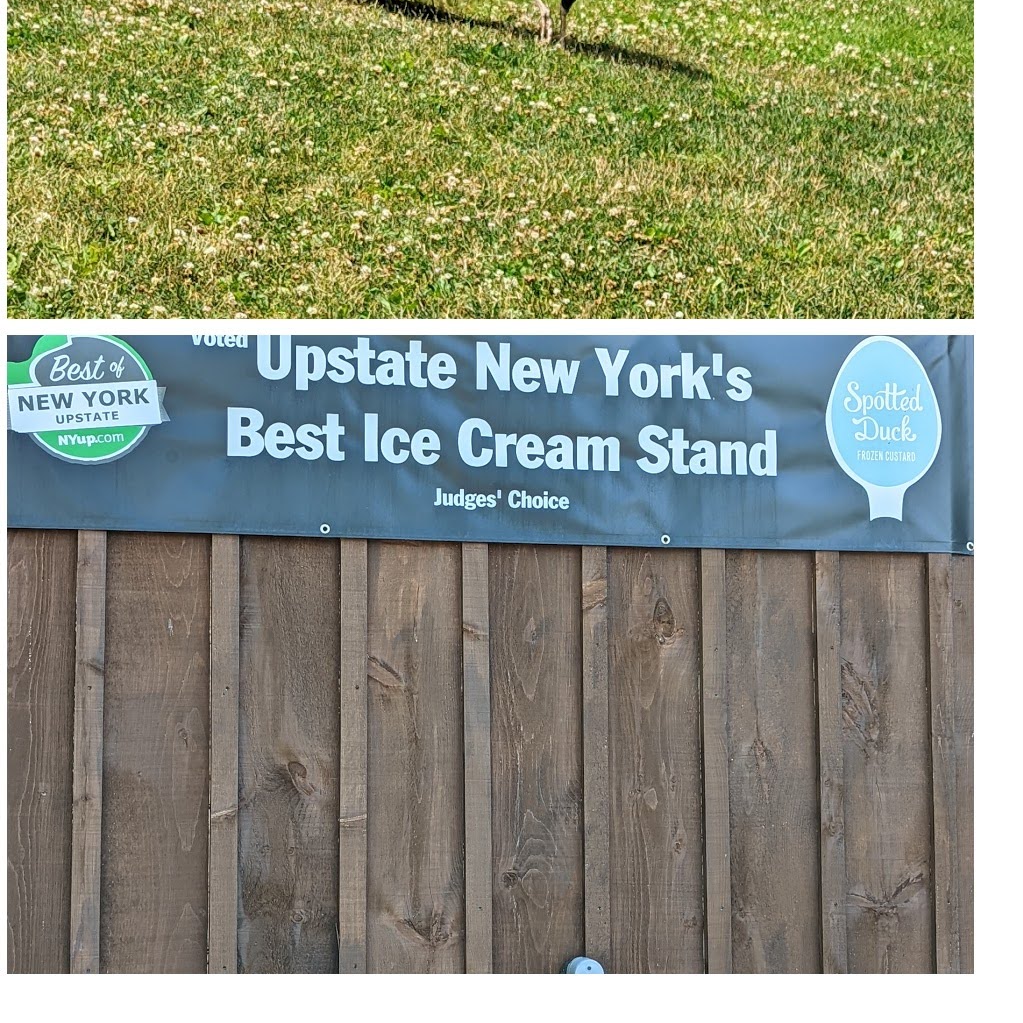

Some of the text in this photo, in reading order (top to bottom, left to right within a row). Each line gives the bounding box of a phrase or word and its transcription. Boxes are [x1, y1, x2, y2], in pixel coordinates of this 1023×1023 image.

[49, 354, 125, 382] Best of
[256, 335, 457, 391] Upstate
[476, 341, 580, 395] New
[594, 347, 753, 402] York's
[18, 387, 150, 412] NEW YORK
[843, 381, 923, 416] Spotted
[55, 411, 120, 425] UPSTATE
[851, 414, 917, 442] Duck
[58, 431, 125, 447] NYup.com
[226, 406, 777, 477] Best Ice Cream Stand
[857, 449, 916, 462] FROZEN CUSTARD
[433, 487, 570, 511] Judges' Choice
